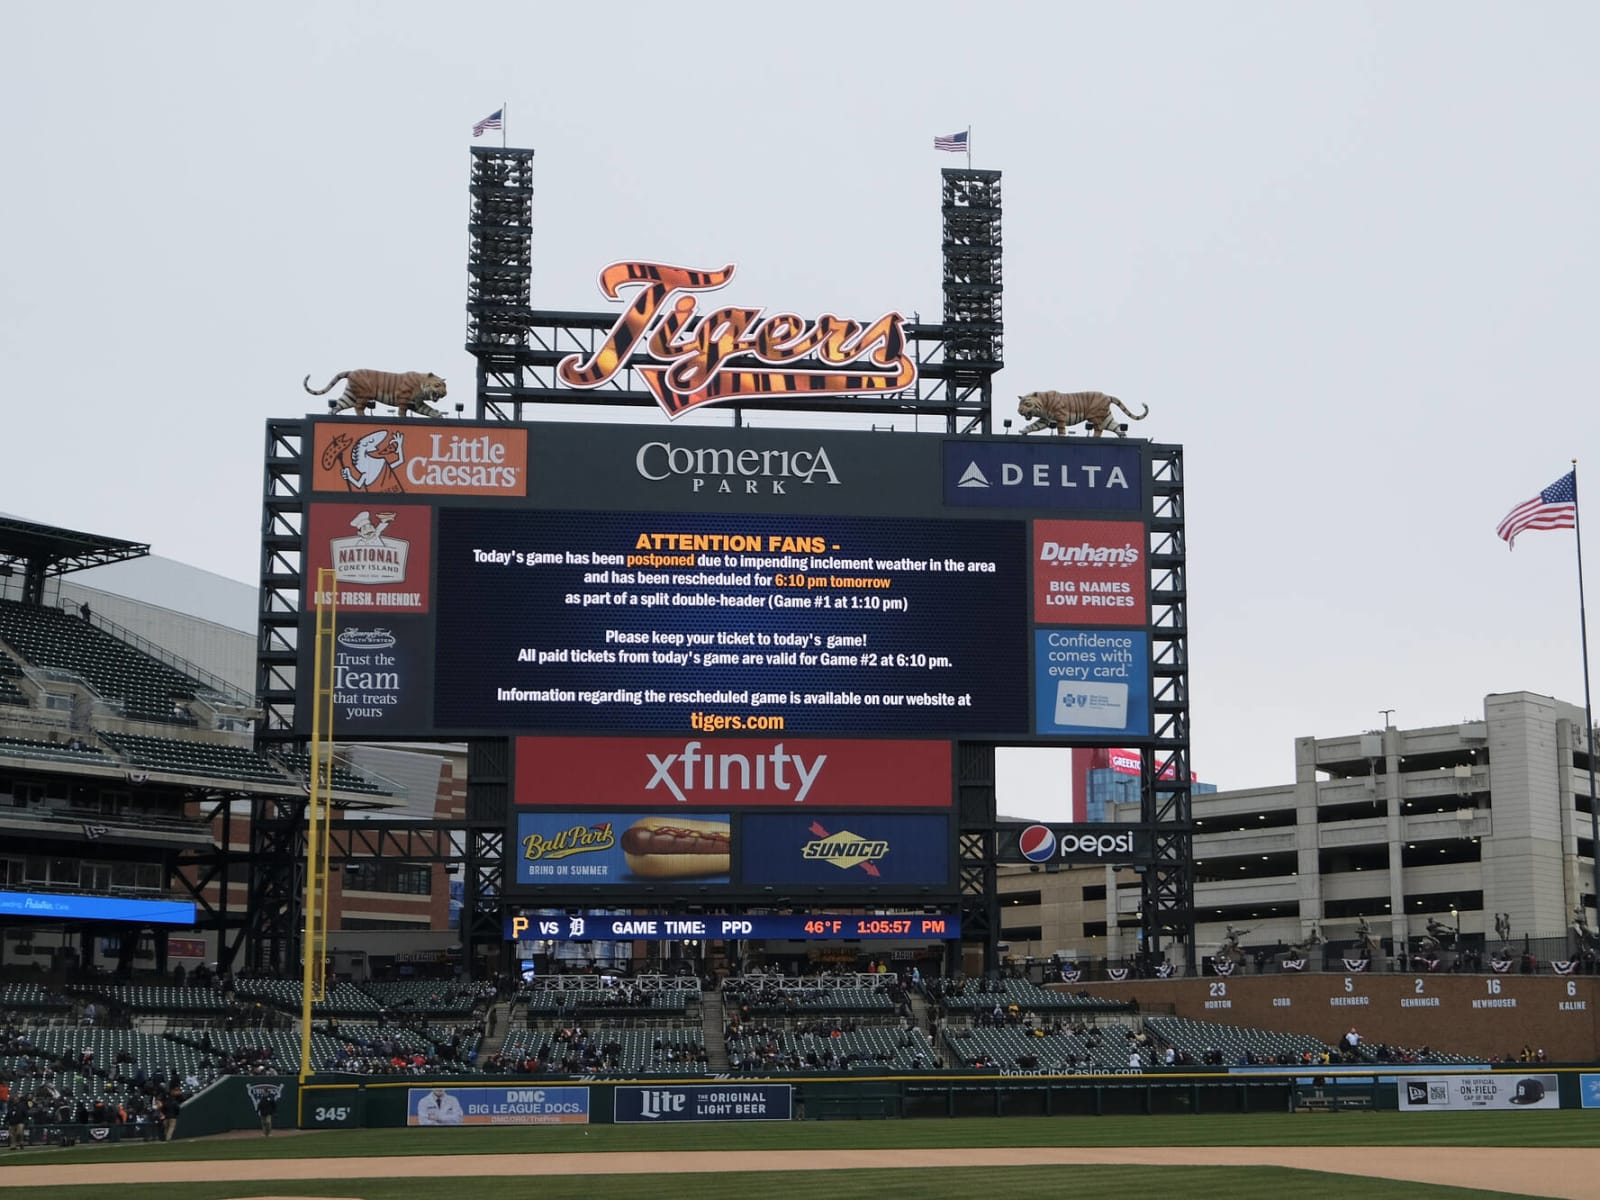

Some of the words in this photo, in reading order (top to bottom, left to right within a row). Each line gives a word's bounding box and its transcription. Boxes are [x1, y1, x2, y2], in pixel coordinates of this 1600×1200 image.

[558, 260, 918, 421] Tigers
[429, 433, 505, 463] Little
[406, 456, 517, 488] Caesars
[1002, 463, 1129, 488] DELTA
[693, 479, 786, 494] PARK
[636, 533, 761, 552] ATTENTION
[769, 536, 826, 553] FANS
[339, 548, 400, 564] NATIONAL
[1040, 542, 1139, 563] Dunham's
[338, 563, 365, 571] CONEY
[368, 563, 399, 572] ISLAND
[473, 549, 524, 566] Today's
[526, 552, 563, 567] game
[566, 551, 590, 565] has
[592, 552, 624, 566] been
[626, 553, 695, 568] postponed
[698, 554, 721, 567] due
[724, 555, 737, 567] to
[740, 555, 808, 571] impending
[810, 556, 873, 570] inclement
[876, 558, 927, 571] weather
[930, 558, 941, 571] in
[944, 559, 965, 571] the
[968, 562, 996, 572] area
[584, 570, 609, 584] and
[611, 571, 635, 584] has
[637, 571, 669, 585] been
[672, 572, 751, 586] rescheduled
[753, 573, 772, 586] for
[775, 574, 804, 587] 6:10
[807, 577, 828, 590] pm
[830, 576, 891, 589] tomorrow
[1050, 581, 1076, 593] BIG
[1080, 582, 1130, 593] NAMES
[341, 592, 374, 605] FRESH.
[376, 592, 421, 606] FRIENDLY.
[565, 594, 580, 604] as
[583, 593, 610, 607] part
[613, 592, 628, 605] of
[630, 595, 637, 604] a
[641, 592, 669, 607] split
[672, 593, 765, 608] double-header
[768, 594, 811, 609] (Game
[814, 596, 831, 609] #1
[834, 597, 848, 609] at
[851, 597, 880, 609] 1:10
[882, 597, 908, 612] pm)
[1046, 595, 1078, 606] LOW
[1082, 595, 1135, 607] PRICES
[605, 630, 649, 644] Please
[651, 631, 684, 645] keep
[686, 634, 714, 647] your
[717, 632, 755, 645] ticket
[757, 634, 771, 645] to
[773, 633, 821, 648] today's
[826, 634, 867, 649] game!
[1048, 633, 1132, 649] Confidence
[337, 652, 371, 665] Trust
[374, 653, 395, 665] the
[518, 648, 536, 662] All
[538, 650, 568, 664] paid
[570, 650, 616, 663] tickets
[618, 651, 649, 663] from
[652, 651, 701, 666] today's
[703, 654, 739, 667] game
[742, 655, 763, 665] are
[766, 653, 797, 665] valid
[799, 653, 818, 665] for
[820, 653, 858, 666] Game
[860, 654, 877, 667] #2
[880, 655, 894, 667] at
[896, 654, 926, 667] 6:10
[928, 656, 952, 670] pm.
[1048, 651, 1096, 662] comes
[1101, 650, 1132, 662] with
[333, 665, 400, 689] Team
[1048, 666, 1090, 680] every
[1093, 664, 1128, 677] card.
[333, 691, 358, 704] that
[362, 693, 397, 704] treats
[497, 688, 575, 702] Information
[578, 689, 642, 704] regarding
[644, 689, 666, 702] the
[669, 690, 748, 704] rescheduled
[751, 694, 787, 707] game
[790, 692, 801, 705] is
[803, 692, 861, 706] available
[864, 695, 880, 705] on
[882, 695, 904, 706] our
[906, 693, 955, 706] website
[957, 694, 971, 706] at
[346, 707, 383, 720] yours
[690, 712, 785, 732] tigers.com
[645, 742, 827, 801] xfinity
[522, 830, 570, 860] Ball
[568, 823, 615, 850] Park
[1061, 831, 1134, 857] pepsi
[804, 842, 886, 857] SUNOCO
[529, 865, 554, 875] BRING
[557, 865, 568, 875] ON
[570, 865, 608, 875] SUMMER
[512, 917, 529, 938] P
[539, 921, 559, 935] VS
[612, 921, 657, 934] GAME
[664, 921, 706, 934] TIME:
[722, 921, 752, 934] PPD
[857, 921, 911, 934] 1:05:57
[922, 921, 945, 934] PM
[1209, 982, 1226, 997] 23
[1344, 978, 1353, 992] 5
[1415, 979, 1424, 993] 2
[1486, 979, 1501, 994] 16
[1567, 981, 1576, 996] 6
[1204, 1000, 1232, 1009] HORTON
[1330, 996, 1369, 1006] GREENBERG
[1400, 997, 1440, 1007] GEHRINGER
[1472, 999, 1517, 1008] NEWHOUSER
[1559, 1001, 1587, 1010] KALINE
[507, 1091, 545, 1103] DMC
[710, 1092, 766, 1102] ORIGINAL
[1460, 1086, 1497, 1095] ON-FIELD
[468, 1104, 489, 1114] BIG
[493, 1104, 541, 1114] LEAGUE
[545, 1103, 583, 1114] DOCS.
[640, 1090, 686, 1118] Lite
[697, 1104, 730, 1114] LIGHT
[735, 1104, 766, 1114] BEER
[315, 1107, 351, 1121] 345'
